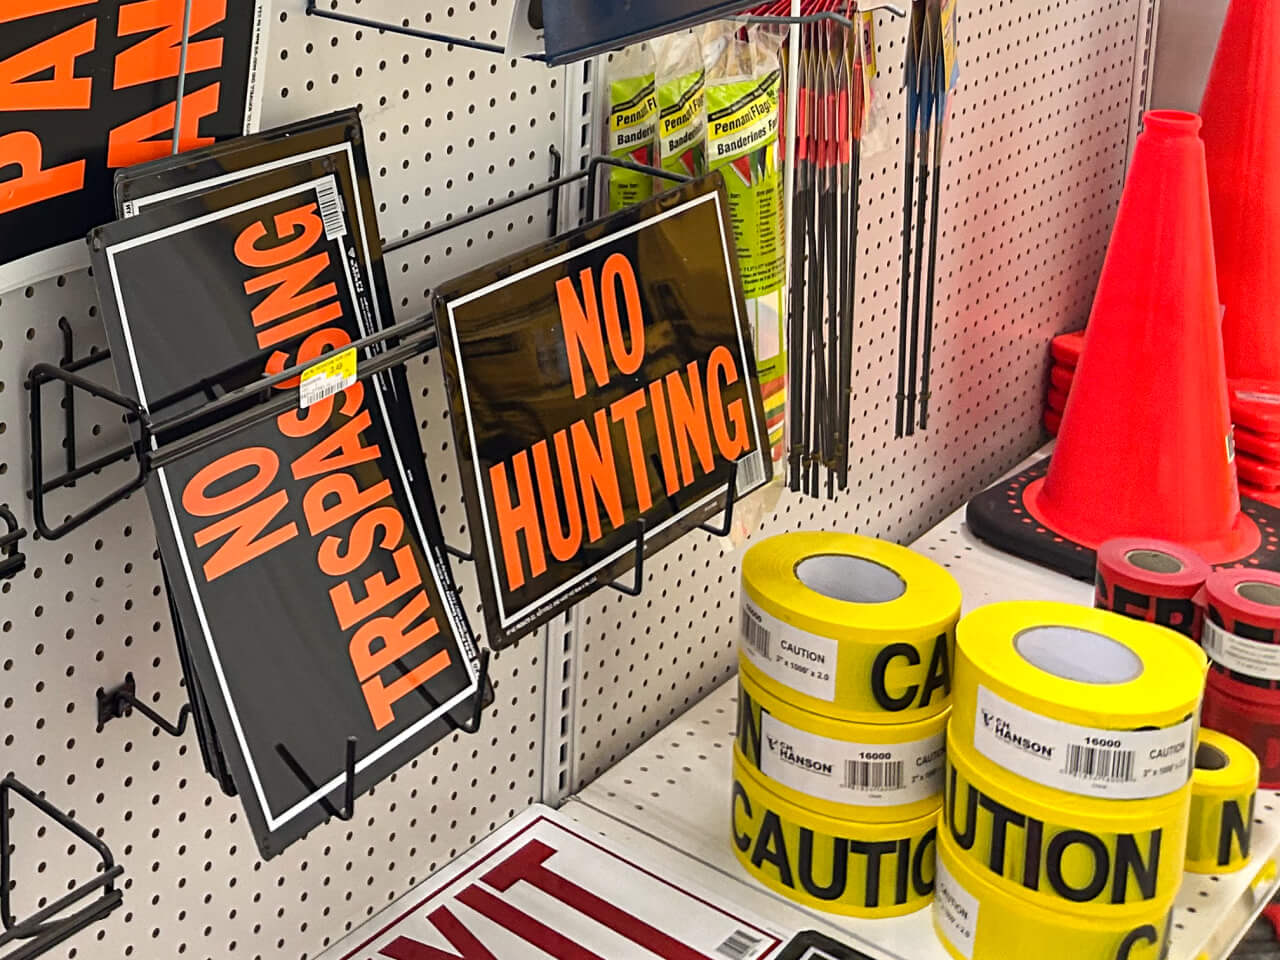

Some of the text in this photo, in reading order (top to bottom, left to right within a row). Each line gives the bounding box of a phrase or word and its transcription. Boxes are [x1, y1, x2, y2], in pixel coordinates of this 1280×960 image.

[714, 111, 752, 135] Pennant
[717, 128, 766, 155] Banderines
[555, 252, 648, 399] NO
[233, 203, 452, 731] TRESPASSING
[487, 345, 751, 591] HUNTING
[182, 445, 298, 583] NO
[780, 640, 825, 665] CAUTION
[996, 726, 1053, 757] HANSON
[1085, 737, 1121, 749] 16000
[1150, 742, 1186, 759] CAUTION
[780, 748, 832, 774] HANSON
[858, 751, 892, 761] 16000
[1218, 792, 1255, 867] N
